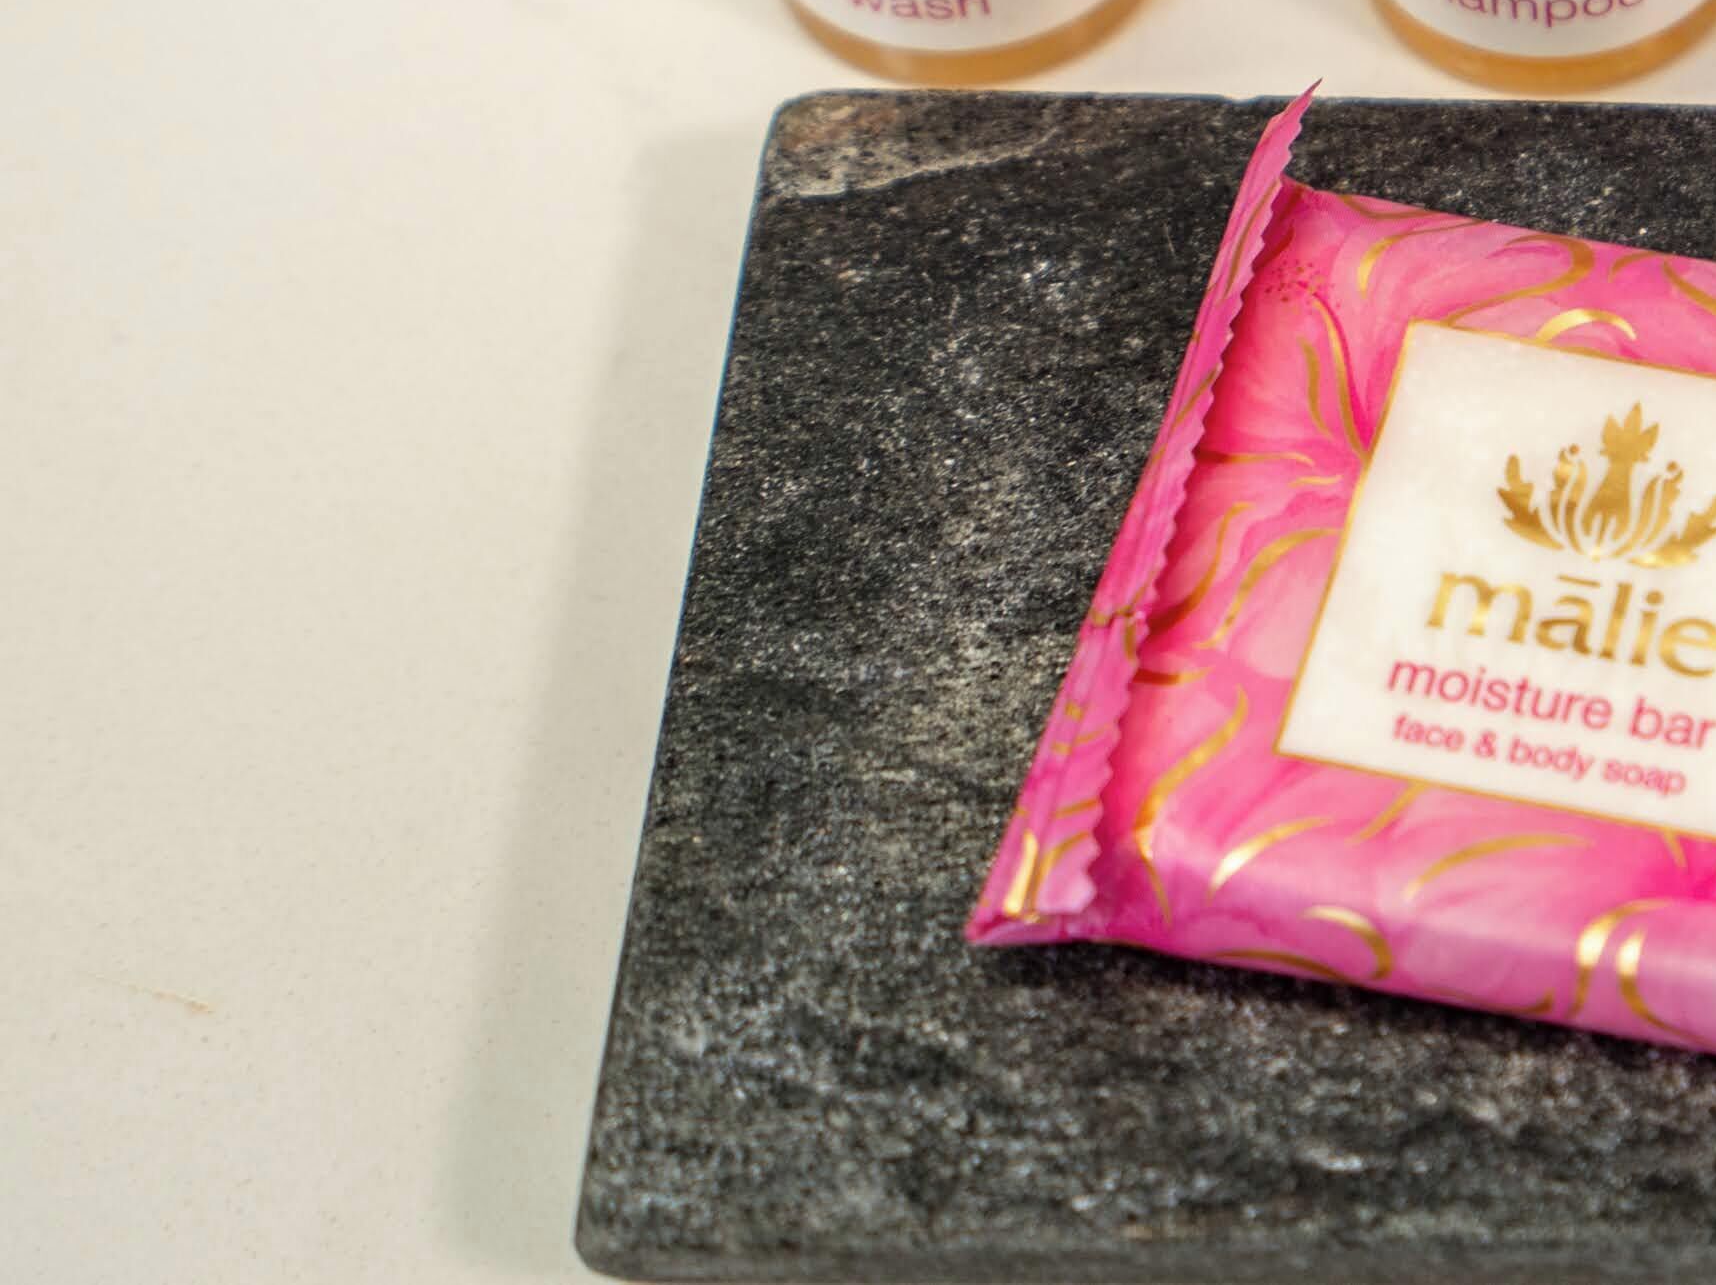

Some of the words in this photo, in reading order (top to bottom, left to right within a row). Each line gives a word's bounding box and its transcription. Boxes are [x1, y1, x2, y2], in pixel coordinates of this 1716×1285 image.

[1386, 659, 1614, 731] moisture
[1392, 714, 1466, 753] face
[1473, 729, 1498, 759] &
[1509, 736, 1596, 782] body
[1603, 757, 1688, 797] soap
